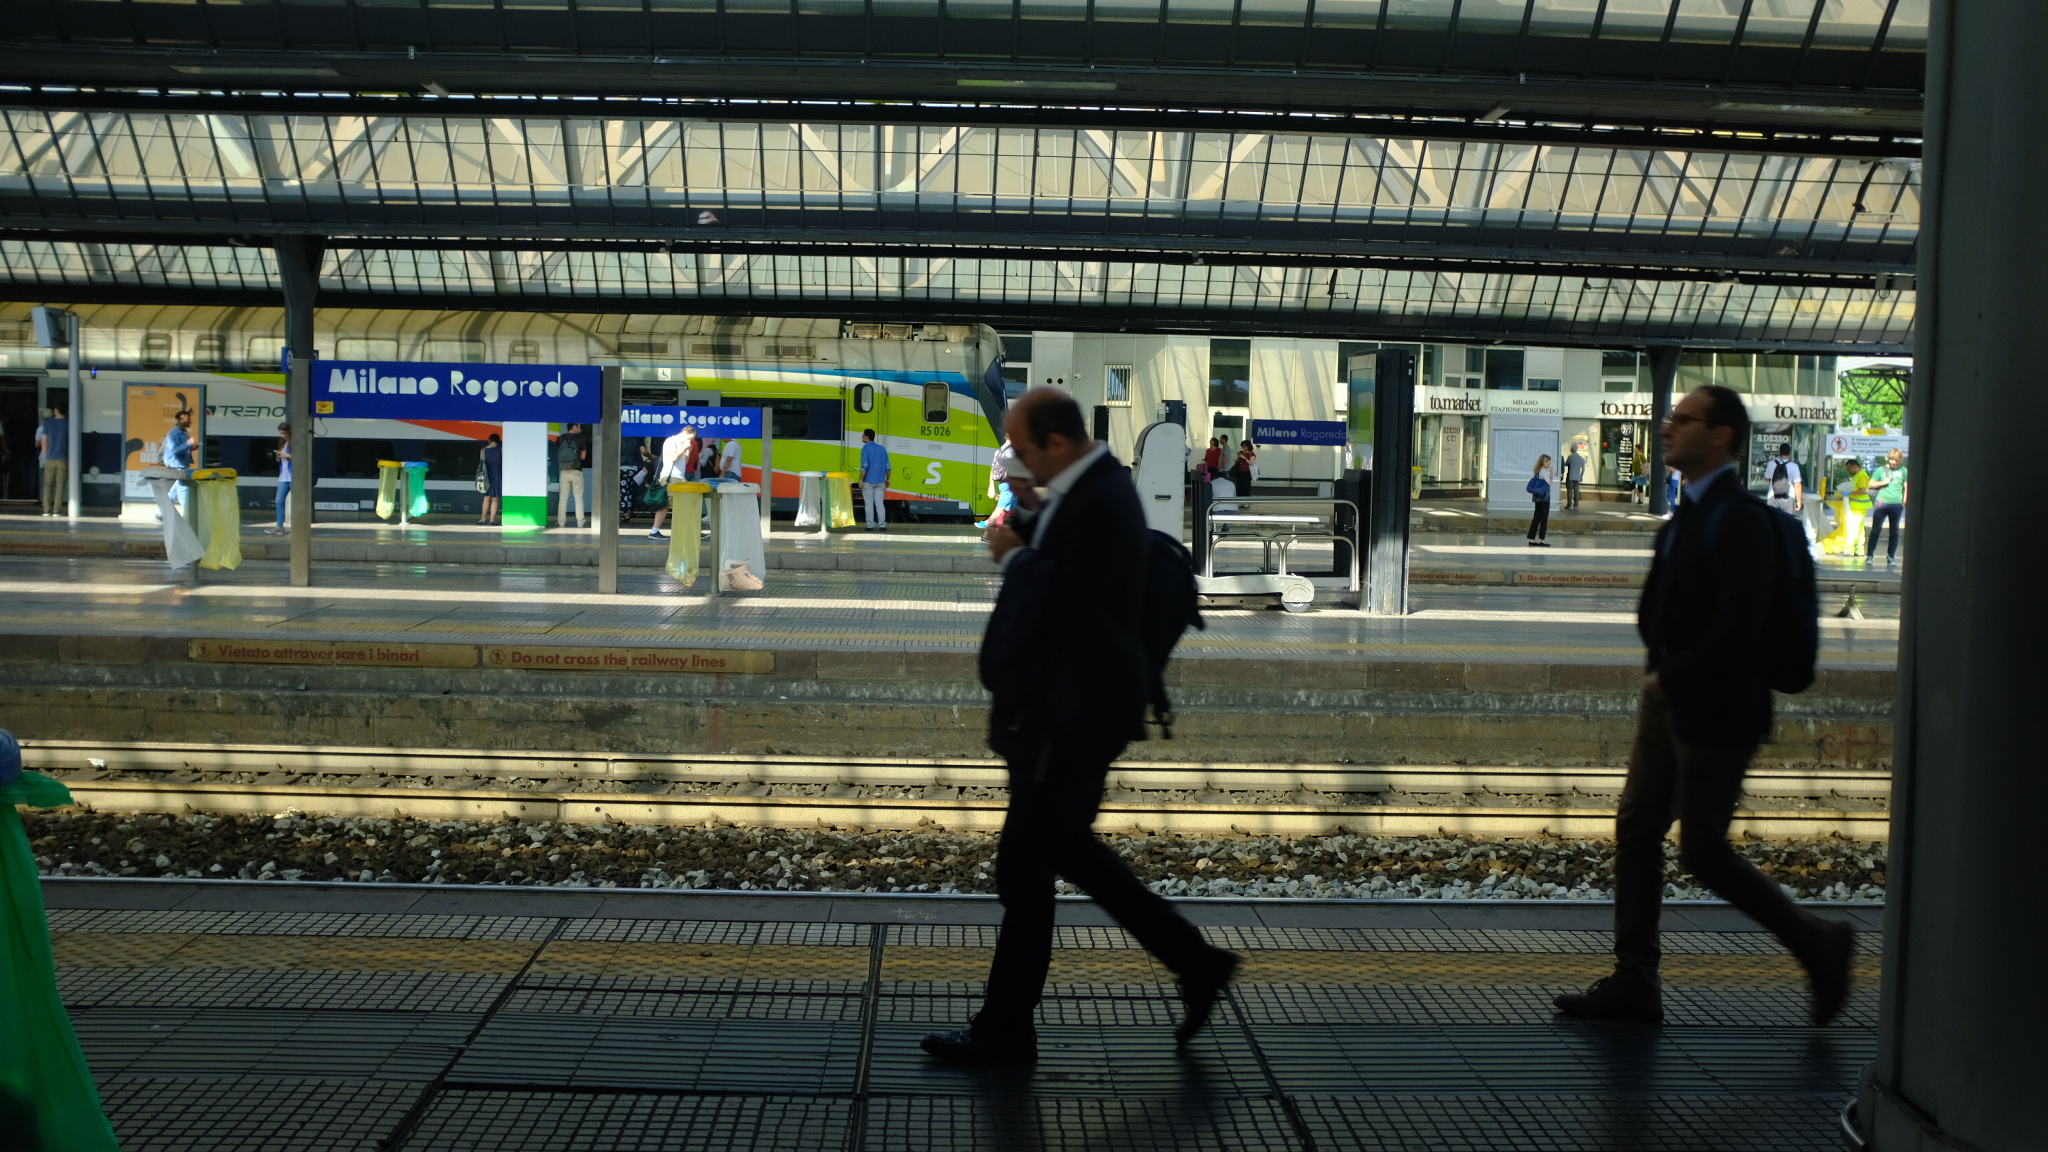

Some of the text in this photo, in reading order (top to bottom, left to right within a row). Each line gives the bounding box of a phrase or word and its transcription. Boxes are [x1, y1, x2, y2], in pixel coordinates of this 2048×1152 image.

[328, 368, 579, 403] Milano Rogoredo
[680, 410, 750, 429] Rogoredo
[934, 426, 951, 436] 026
[1256, 427, 1298, 438] Milano
[1756, 434, 1789, 443] ADESSO
[144, 442, 157, 452] LA
[1584, 576, 1610, 584] railway
[217, 645, 270, 658] Vietato
[376, 648, 420, 661] binari
[512, 651, 726, 669] Do not cross the railway lines
